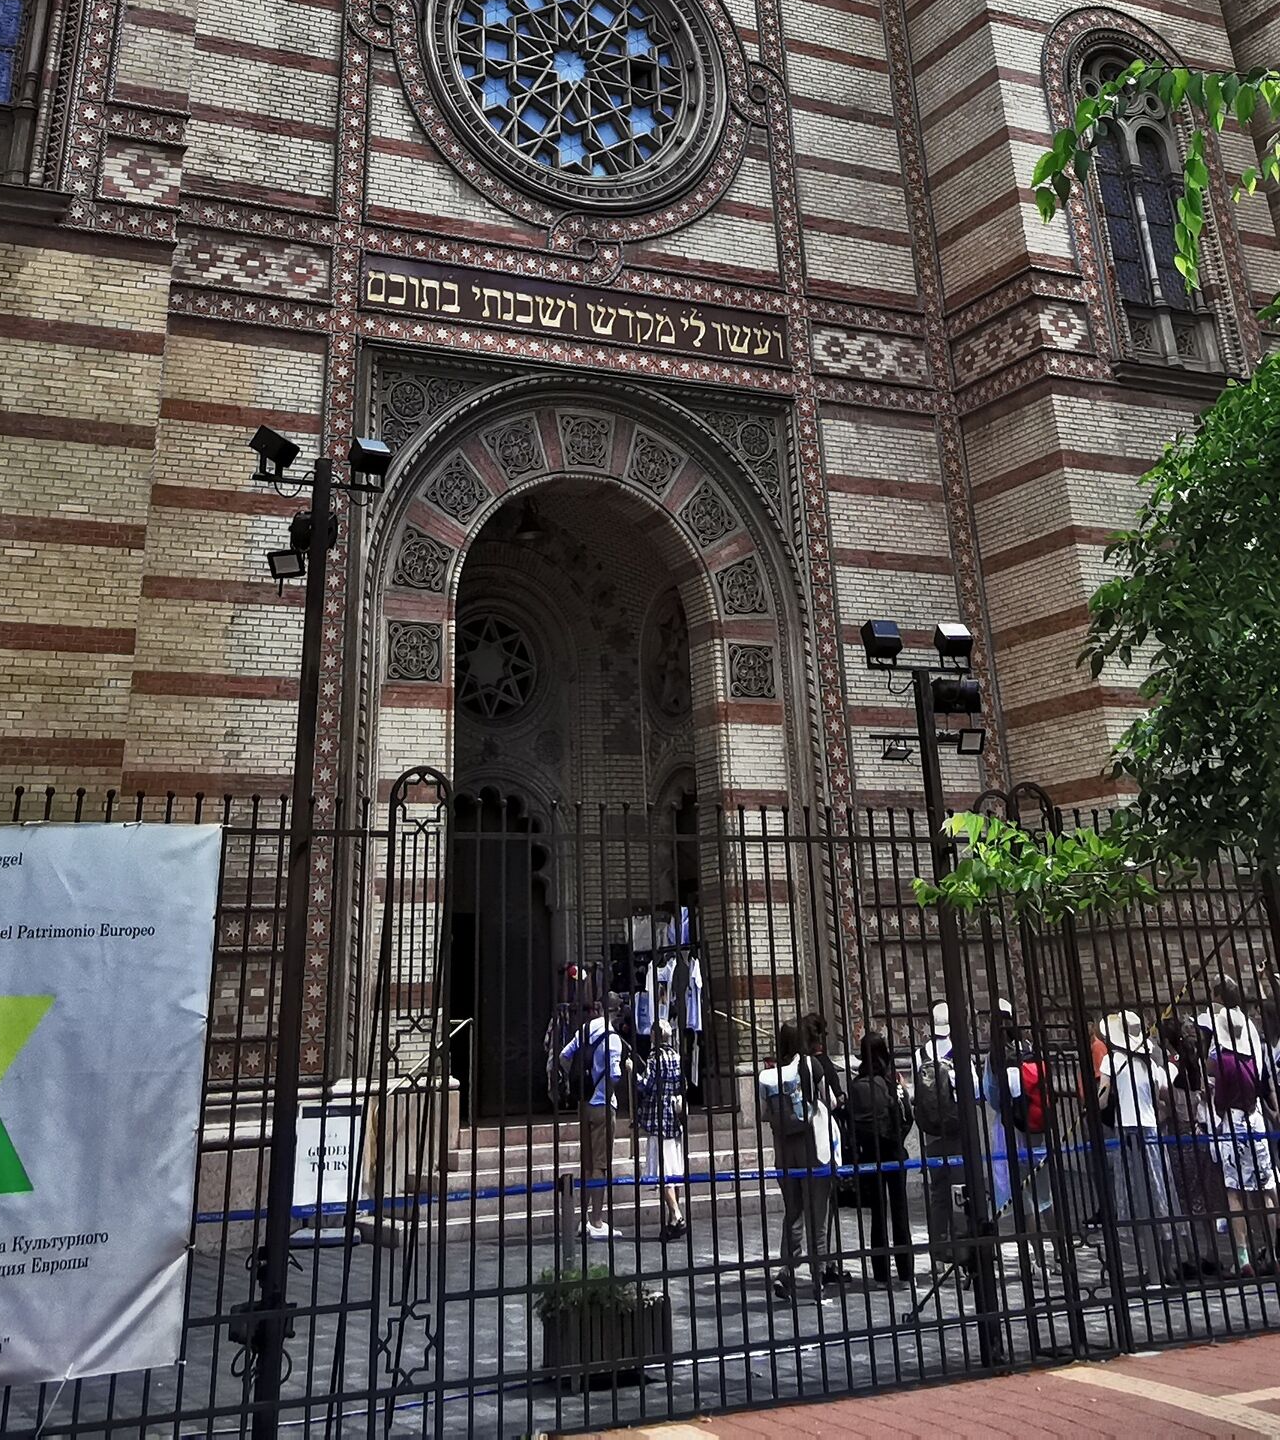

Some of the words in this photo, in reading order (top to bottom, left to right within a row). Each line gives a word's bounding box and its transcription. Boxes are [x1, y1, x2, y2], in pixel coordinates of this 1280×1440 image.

[367, 270, 461, 313] בתוכם
[471, 284, 578, 331] ושכנתי
[586, 302, 676, 346] מקדש
[679, 307, 706, 347] לי
[710, 320, 784, 360] ועשו
[17, 924, 95, 939] Patrimonio
[99, 923, 156, 939] Europeo
[11, 1232, 109, 1255] Культурного
[31, 1256, 89, 1276] Европы
